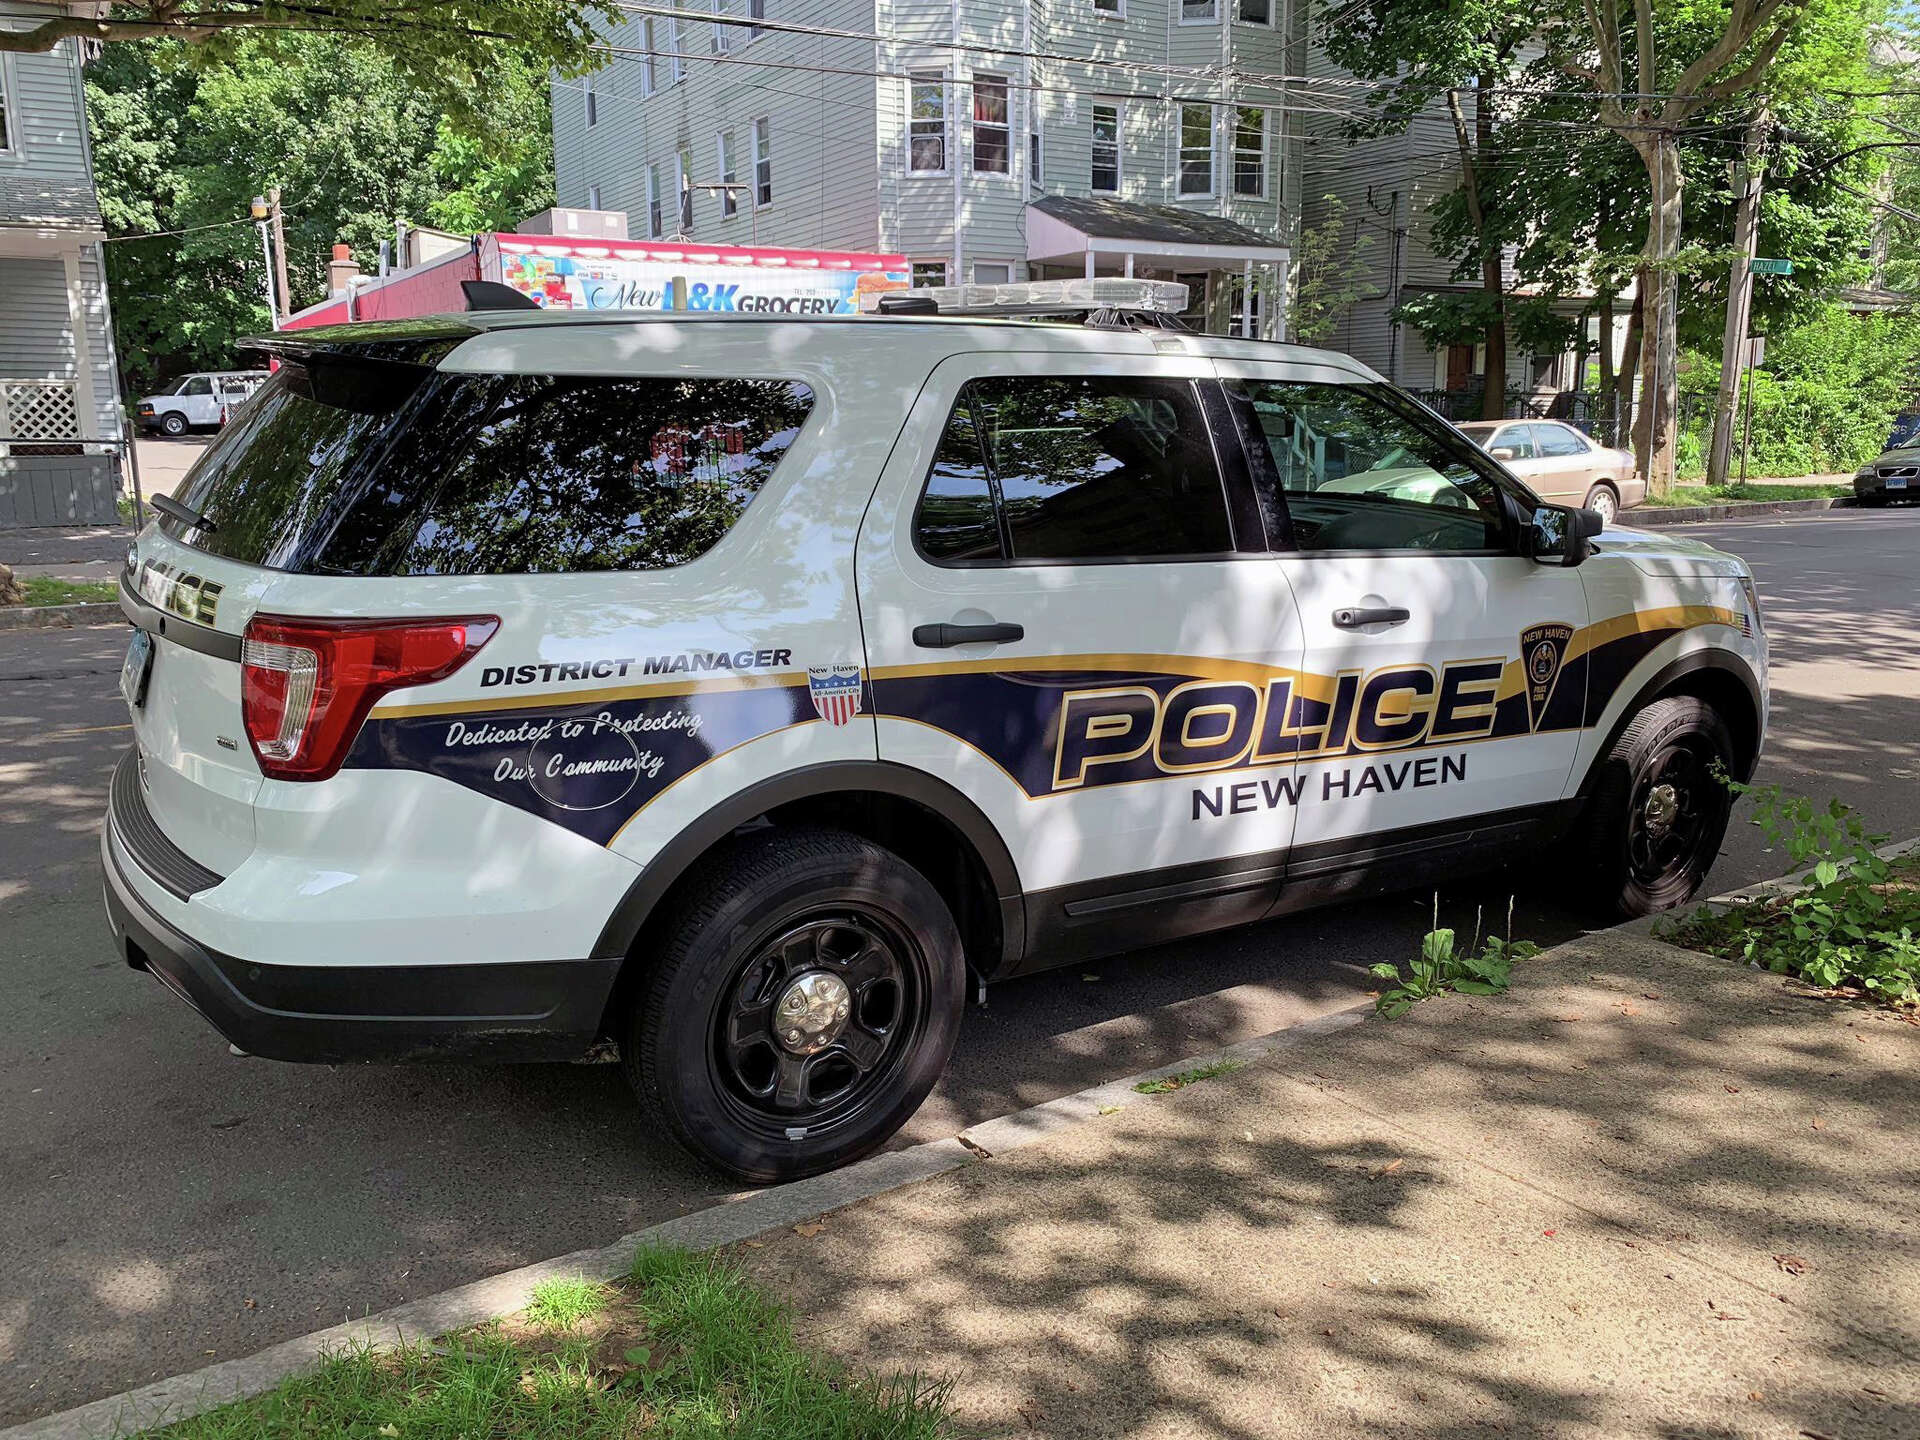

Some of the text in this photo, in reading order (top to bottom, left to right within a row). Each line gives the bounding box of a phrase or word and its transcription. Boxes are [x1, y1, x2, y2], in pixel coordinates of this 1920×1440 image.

[1753, 261, 1776, 271] HAZEL
[591, 280, 663, 310] New
[738, 295, 841, 313] GROCERY
[1523, 629, 1571, 644] NEW HAVEN
[480, 649, 791, 687] DISTRICT MANAGER
[808, 665, 859, 674] New Haven
[445, 711, 704, 747] Dedicated to Protecting
[1051, 656, 1507, 791] POLICE
[493, 751, 665, 782] Our Community
[1192, 753, 1467, 821] NEW HAVEN
